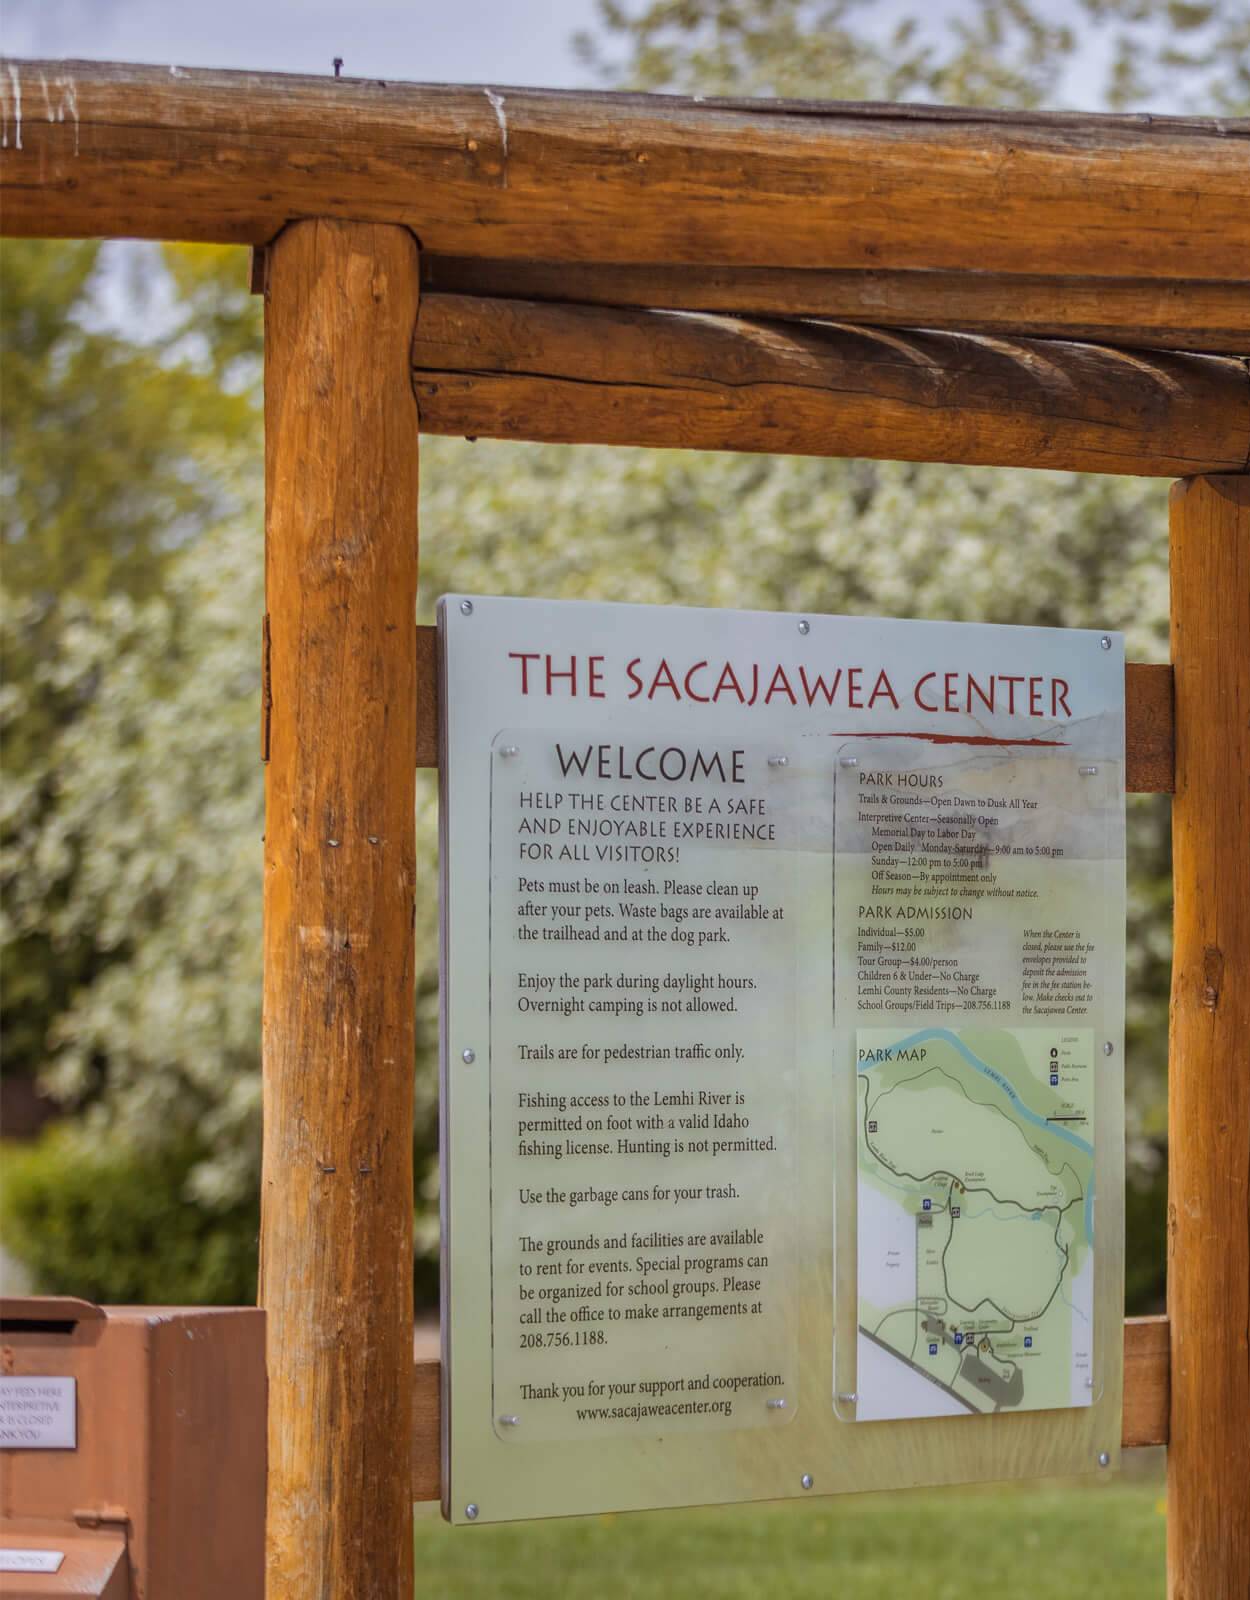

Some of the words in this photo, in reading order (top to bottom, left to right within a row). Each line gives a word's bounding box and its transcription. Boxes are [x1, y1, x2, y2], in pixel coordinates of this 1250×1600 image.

[508, 652, 605, 698] THE
[626, 657, 899, 710] SACAJAWEA
[914, 671, 1072, 717] CENTER
[555, 743, 745, 783] WELCOME
[859, 771, 893, 786] PARK
[897, 773, 943, 788] HOURS
[520, 791, 563, 809] HELP
[567, 793, 604, 811] THE
[610, 794, 677, 812] CENTER
[684, 796, 702, 813] BE
[708, 797, 721, 814] A
[727, 798, 765, 815] SAFE
[858, 792, 879, 803] Trails
[880, 794, 888, 804] &
[953, 796, 976, 807] Dawn
[977, 799, 986, 807] to
[986, 797, 1007, 808] Dusk
[1008, 798, 1020, 808] All
[1021, 799, 1038, 808] Year
[518, 817, 561, 834] AND
[568, 818, 666, 838] ENJOYABLE
[673, 821, 775, 840] EXPERIENCE
[871, 827, 909, 837] Memorial
[909, 827, 926, 840] Day
[927, 829, 935, 838] to
[936, 828, 959, 838] Labor
[960, 828, 977, 841] Day
[519, 842, 553, 860] FOR
[558, 844, 590, 861] ALL
[595, 844, 679, 863] VISITORS!
[858, 904, 892, 919] PARK
[896, 906, 972, 920] ADMISSION
[857, 956, 876, 966] Tour
[518, 972, 556, 992] Enjoy
[559, 971, 579, 988] the
[583, 972, 613, 993] park
[616, 972, 660, 992] during
[662, 972, 714, 992] daylight
[717, 973, 757, 989] hours.
[857, 970, 891, 981] Children
[892, 970, 898, 980] 6
[899, 970, 906, 981] &
[952, 971, 980, 984] Charge
[517, 995, 584, 1016] Overnight
[588, 997, 644, 1016] camping
[647, 997, 658, 1012] is
[661, 999, 682, 1012] not
[685, 996, 737, 1012] allowed.
[857, 999, 884, 1011] School
[884, 999, 934, 1012] Groups/Field
[517, 1043, 554, 1060] Trails
[557, 1048, 578, 1059] are
[581, 1043, 600, 1059] for
[604, 1043, 670, 1064] pedestrian
[674, 1042, 711, 1059] traffic
[714, 1043, 744, 1063] only.
[858, 1048, 892, 1062] PARK
[896, 1048, 926, 1061] MAP
[519, 1188, 543, 1204] Use
[545, 1187, 566, 1203] the
[569, 1186, 618, 1207] garbage
[621, 1190, 649, 1201] cans
[652, 1184, 671, 1200] for
[673, 1188, 703, 1204] your
[705, 1182, 740, 1199] trash.
[519, 1329, 607, 1348] 208.756.1188.
[519, 1382, 559, 1400] Thank
[561, 1385, 585, 1401] you
[587, 1379, 605, 1396] for
[607, 1383, 636, 1399] your
[638, 1378, 684, 1397] support
[687, 1374, 709, 1391] and
[712, 1372, 784, 1392] cooperation.
[576, 1400, 732, 1420] www.sacajaweacenter.org
